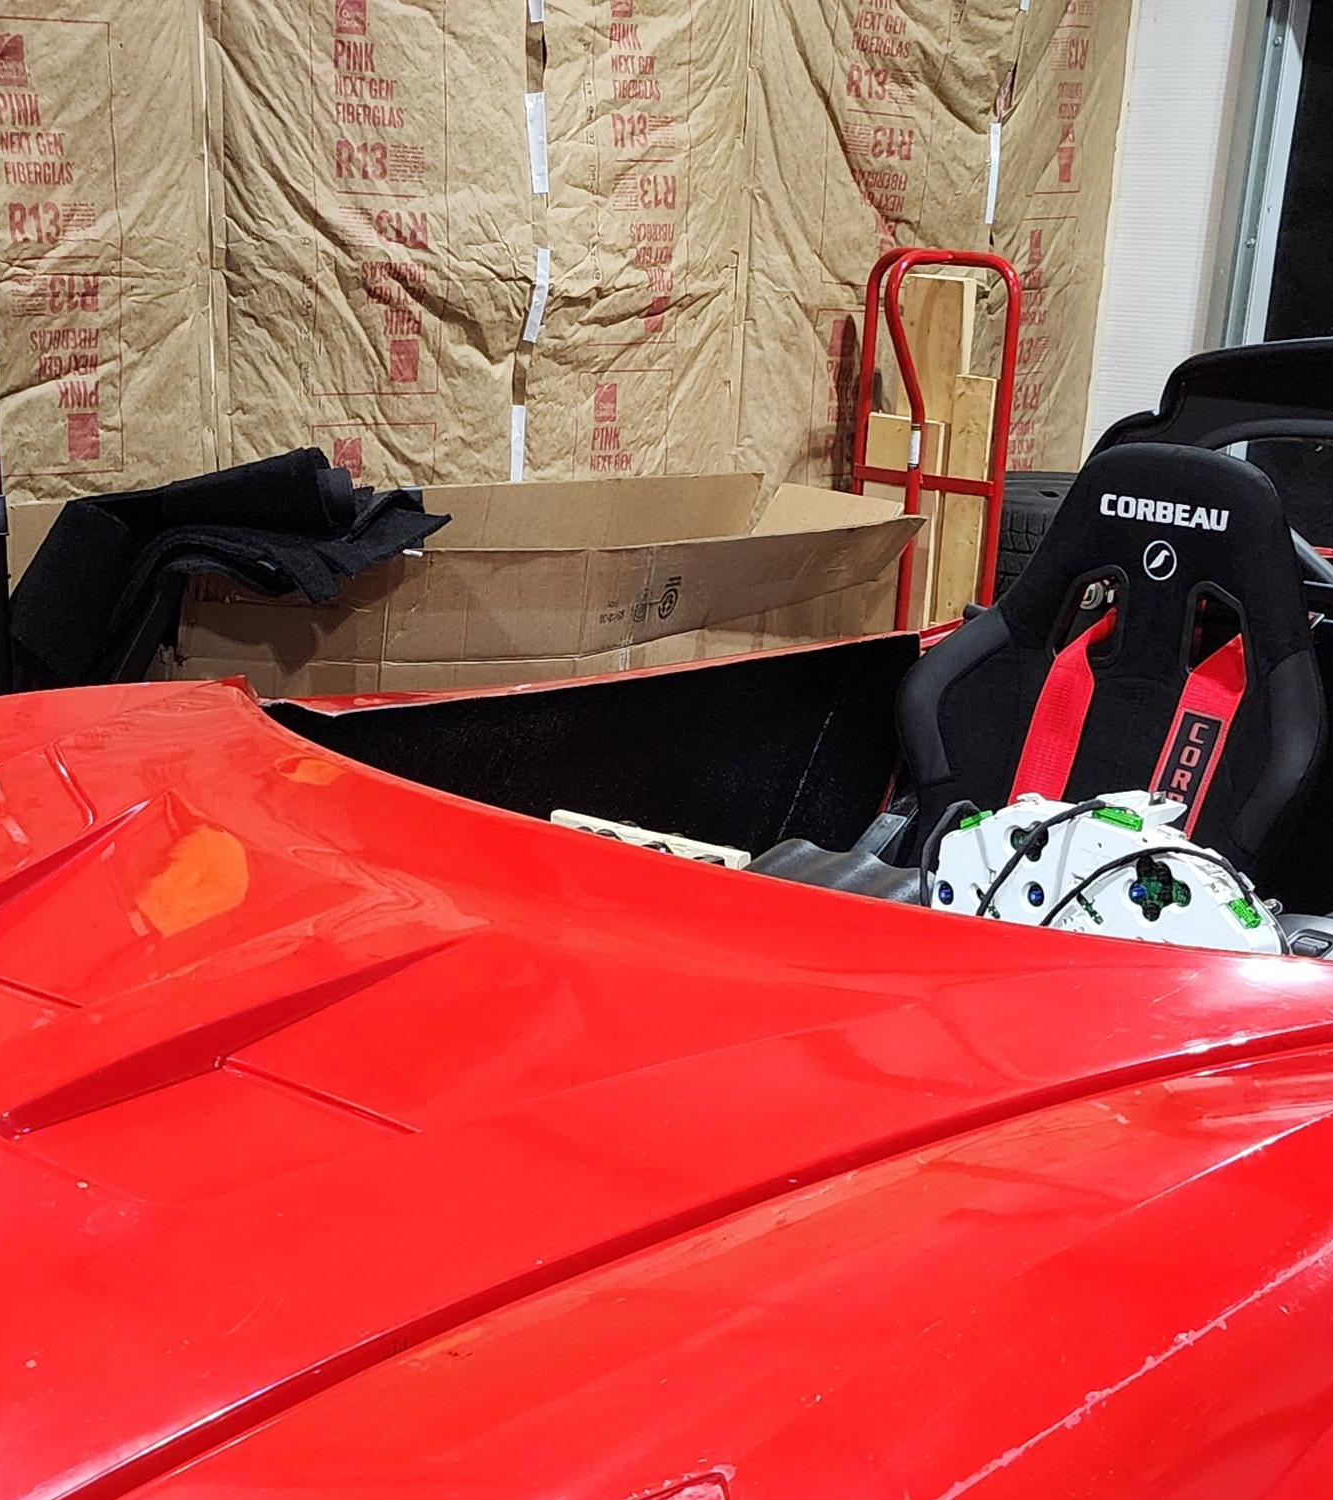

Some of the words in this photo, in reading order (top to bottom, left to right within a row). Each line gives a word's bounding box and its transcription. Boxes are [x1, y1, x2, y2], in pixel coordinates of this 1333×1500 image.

[608, 23, 642, 51] PINK
[853, 10, 884, 32] NEXT
[884, 15, 908, 36] GEN
[333, 39, 376, 73] PINK
[851, 31, 912, 59] FIBERGLAS
[611, 54, 636, 75] NEXT
[637, 56, 658, 75] GEN
[334, 75, 365, 99] NEXT
[368, 79, 395, 101] GEN
[612, 79, 662, 101] FIBERGLAS
[846, 62, 889, 101] R13
[334, 102, 406, 129] FIBERGLAS
[0, 131, 33, 156] NEXT
[34, 132, 66, 157] GEN
[610, 112, 648, 150] R13
[870, 125, 915, 161] R13
[3, 161, 76, 186] FIBERGLAS
[335, 139, 389, 180] R13
[639, 174, 677, 210] R13
[7, 200, 62, 245] R13
[374, 209, 429, 250] R13
[48, 272, 100, 315] R13
[383, 308, 423, 336] PINK
[29, 327, 100, 351] FIBERGLAS
[39, 355, 65, 381] GEN
[67, 354, 99, 377] NEXT
[57, 379, 101, 409] PINK
[591, 427, 622, 451] PINK
[589, 454, 612, 473] NEXT
[614, 453, 633, 472] GEN
[1099, 493, 1231, 533] CORBEAU
